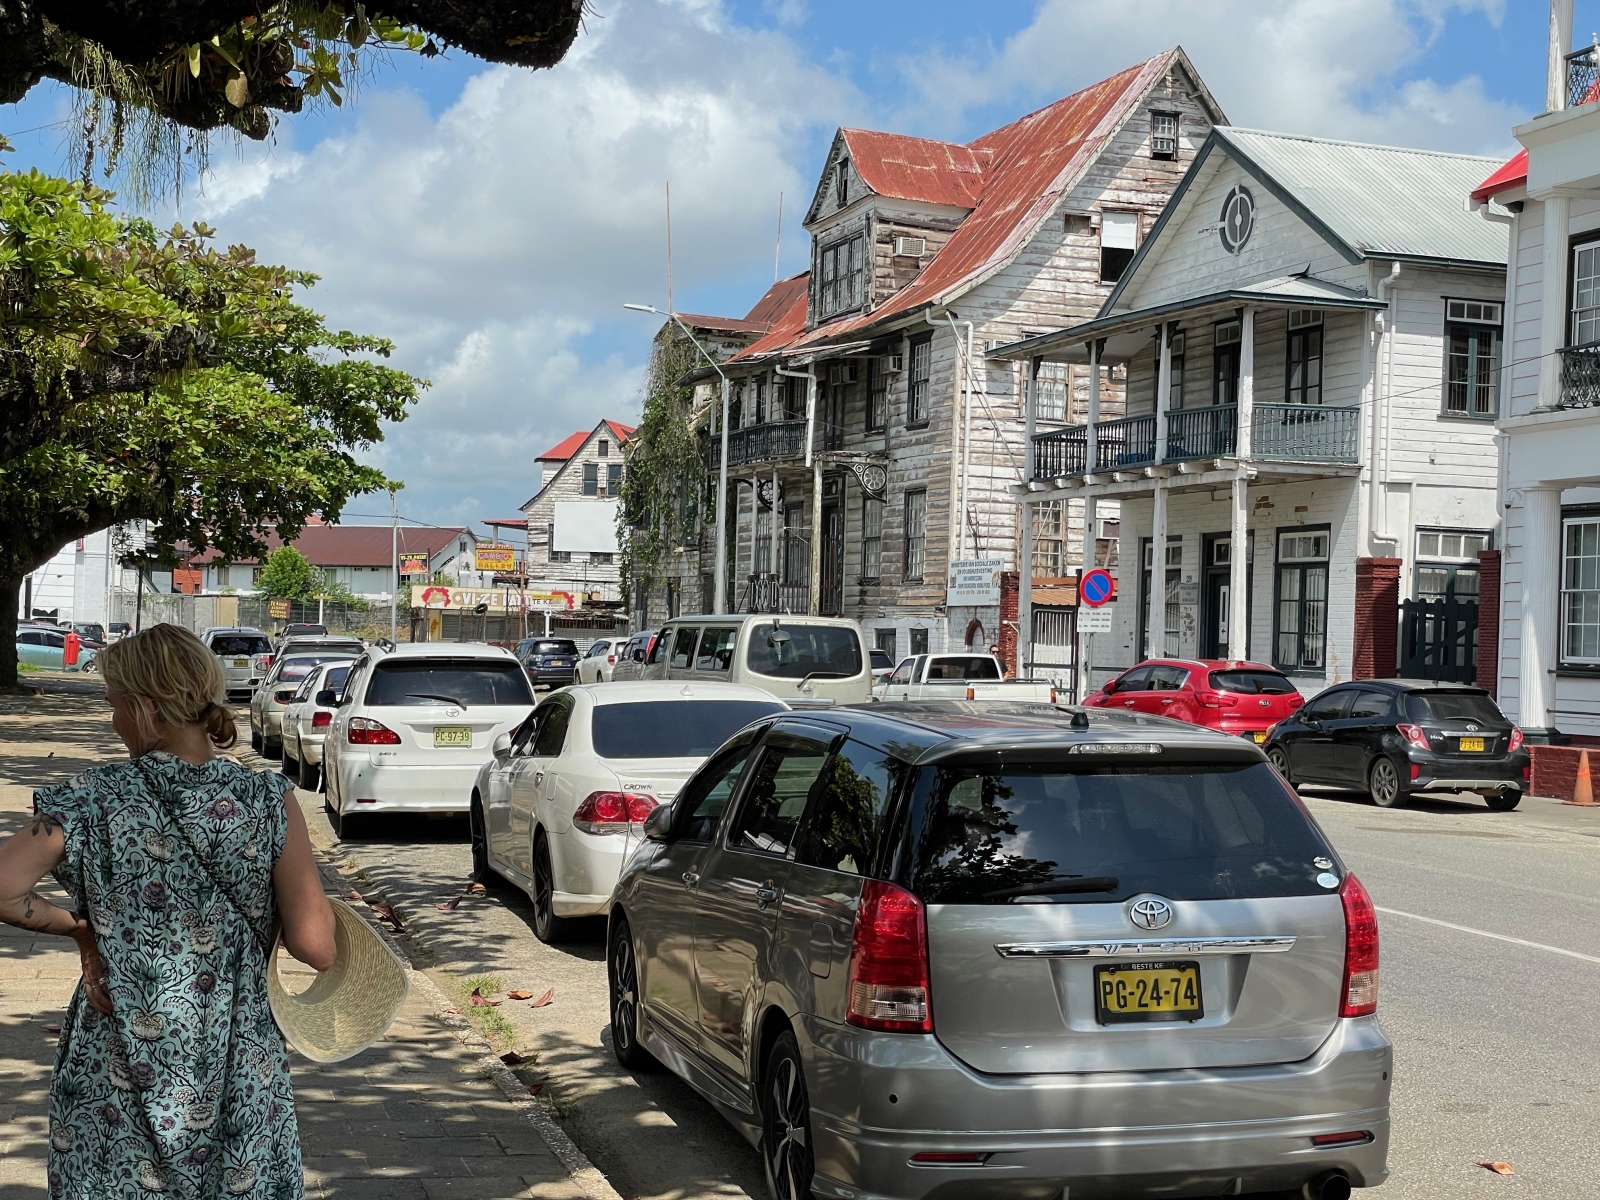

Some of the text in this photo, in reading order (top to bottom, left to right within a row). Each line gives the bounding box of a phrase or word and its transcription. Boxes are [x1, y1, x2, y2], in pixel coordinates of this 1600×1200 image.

[462, 592, 498, 606] VI-ZE
[435, 731, 470, 742] PC-97-39
[1103, 942, 1204, 954] WISH
[1101, 977, 1197, 1009] PG-24-74
